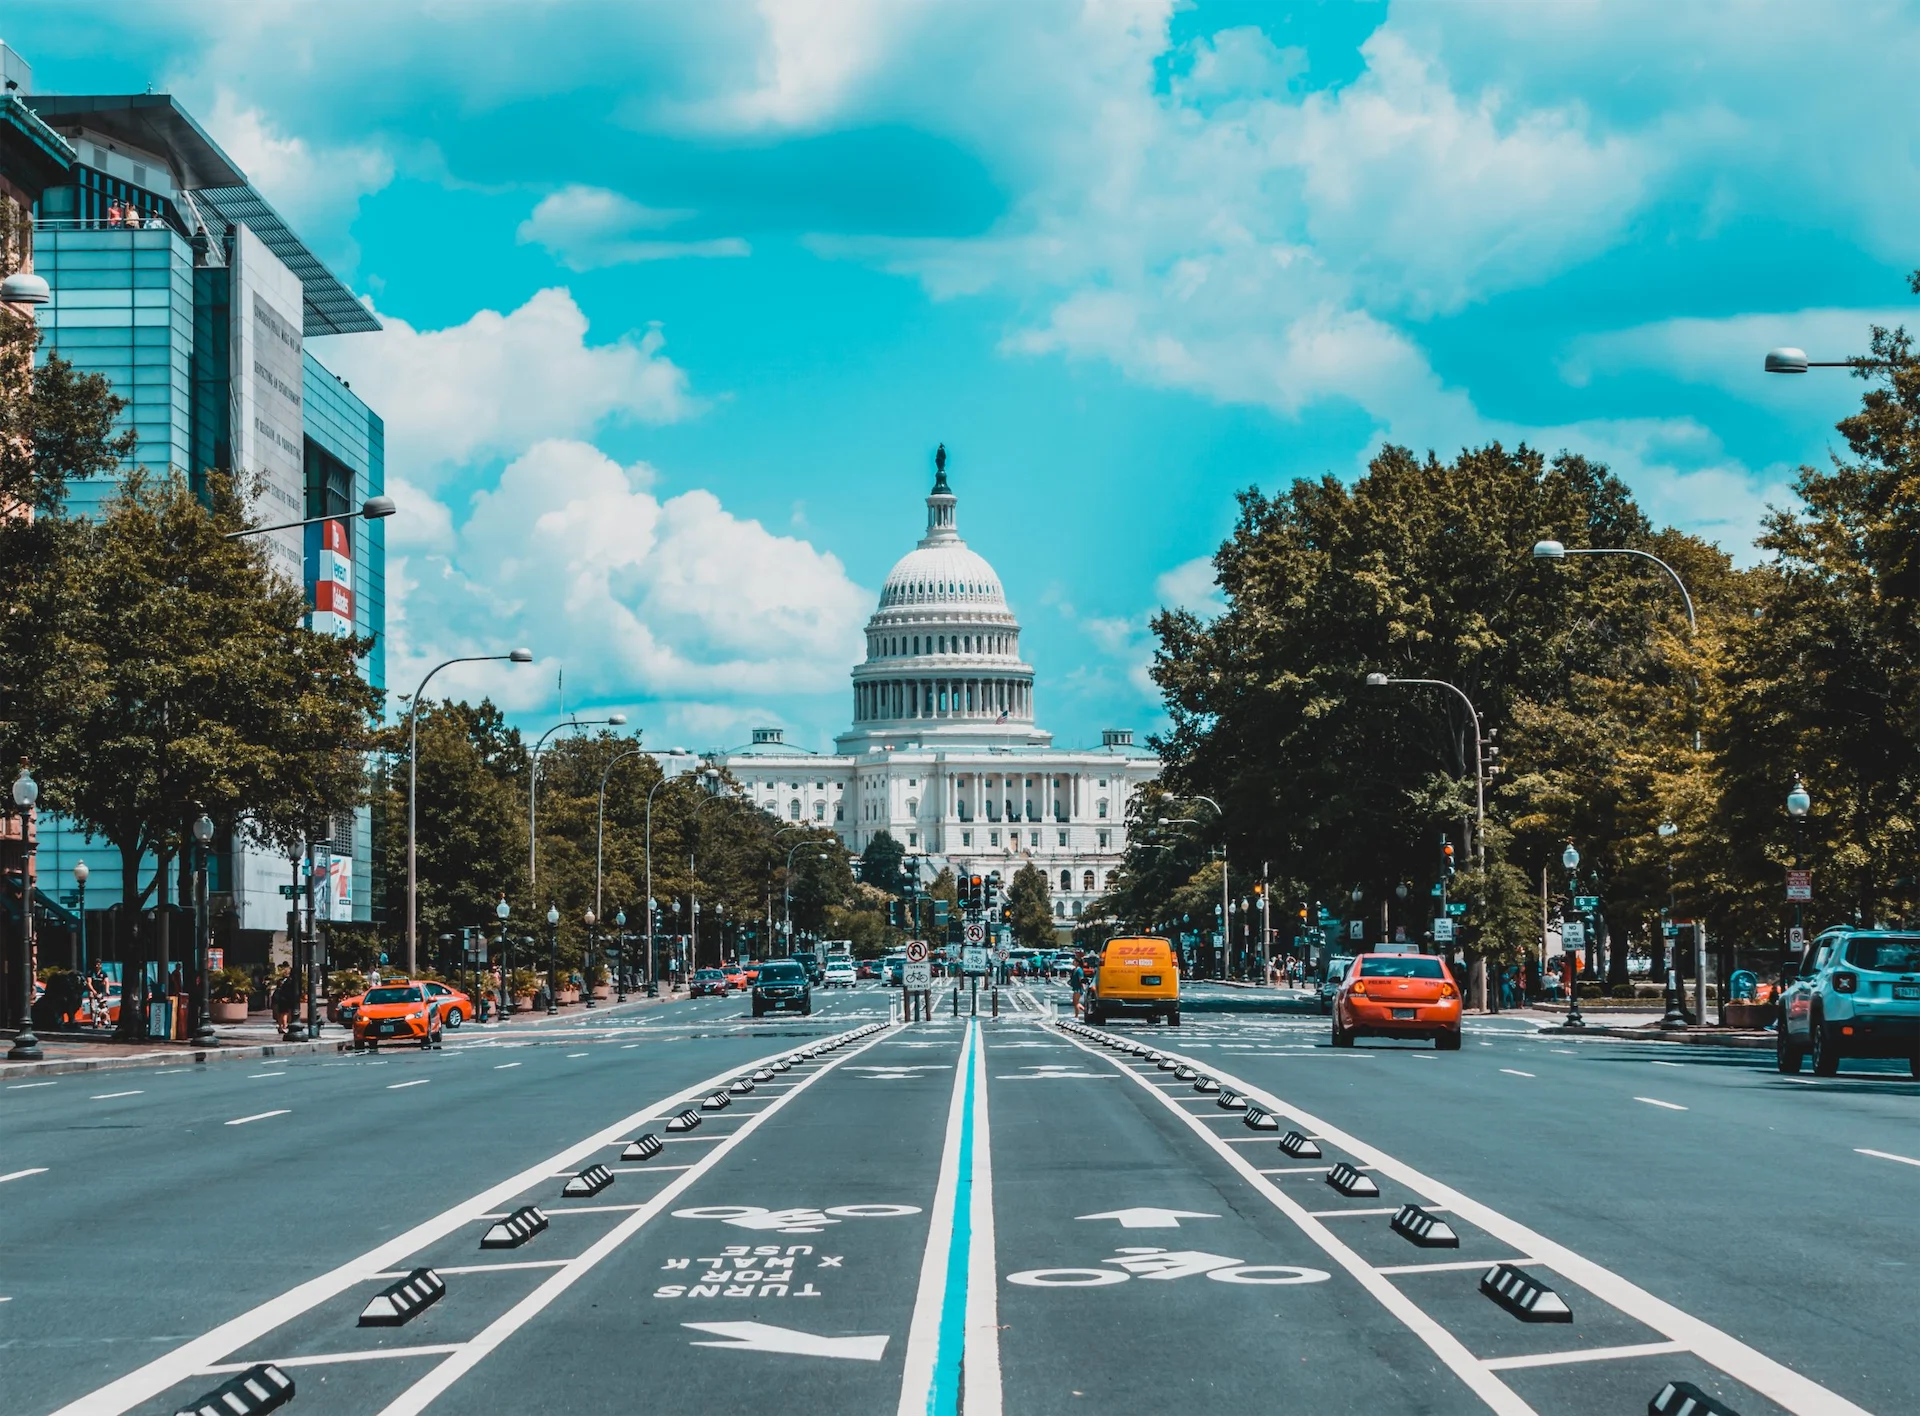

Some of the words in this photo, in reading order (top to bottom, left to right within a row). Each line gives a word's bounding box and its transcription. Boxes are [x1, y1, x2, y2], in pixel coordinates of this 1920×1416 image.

[1118, 947, 1158, 955] DHL
[720, 1245, 813, 1256] USE
[660, 1256, 795, 1269] WALK
[817, 1256, 844, 1267] X
[700, 1270, 793, 1283] FOR
[652, 1282, 821, 1298] TURNS
